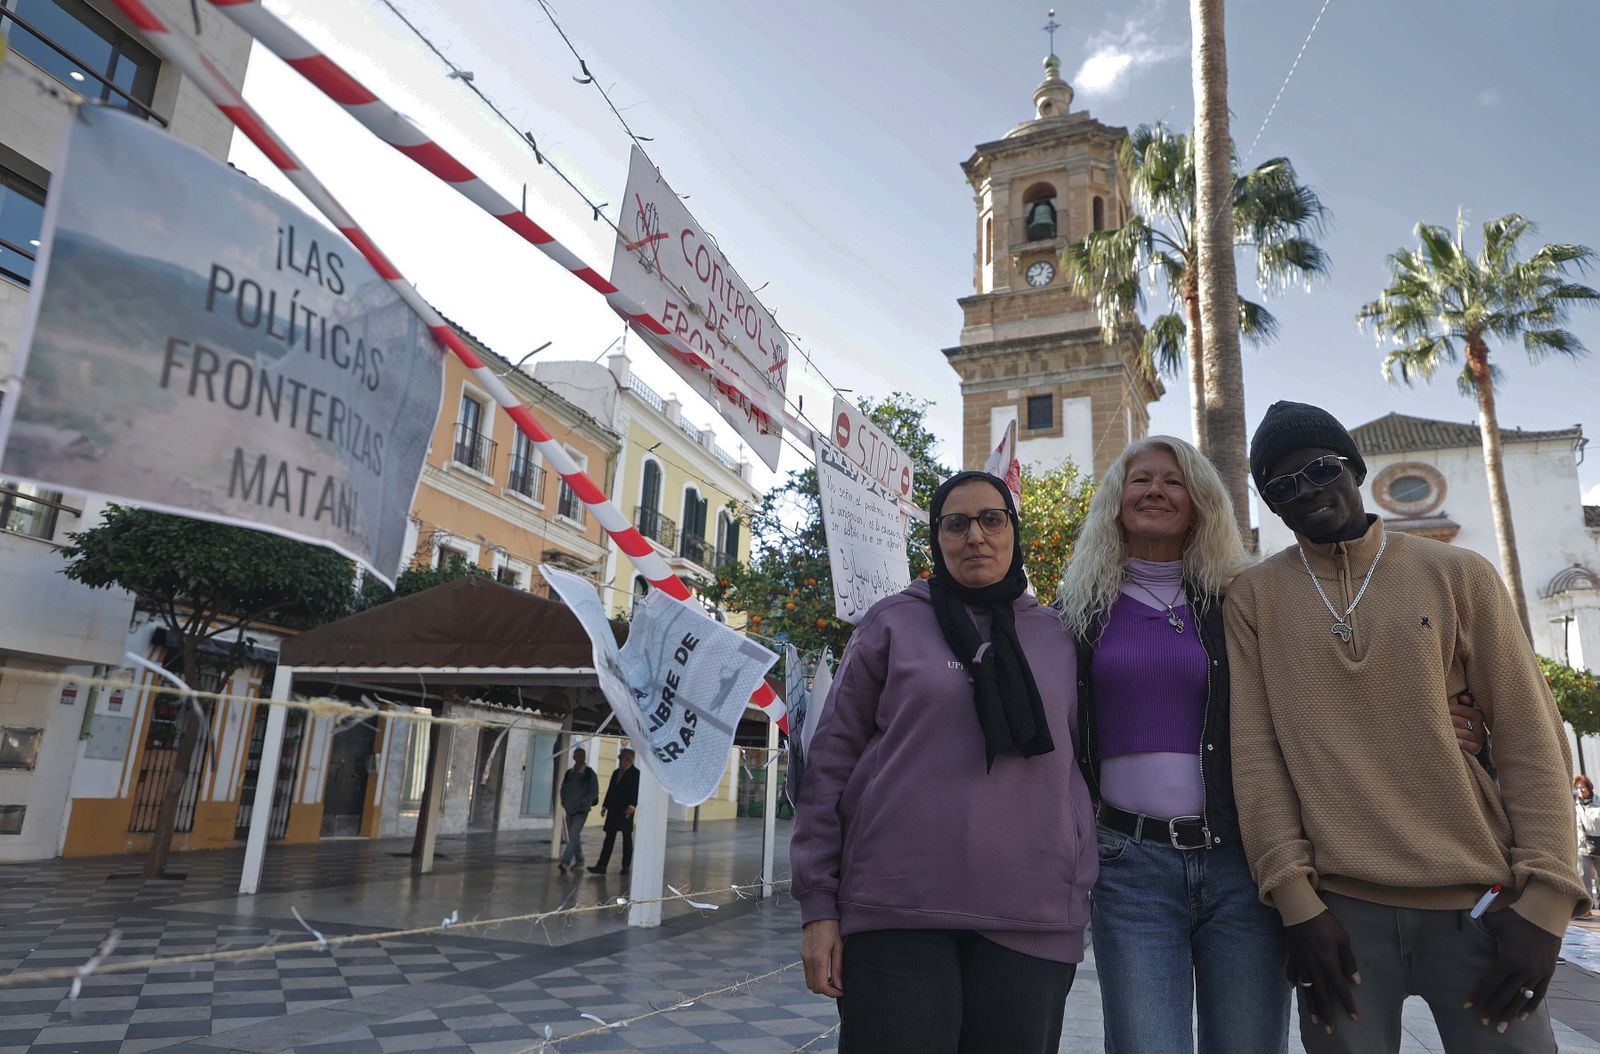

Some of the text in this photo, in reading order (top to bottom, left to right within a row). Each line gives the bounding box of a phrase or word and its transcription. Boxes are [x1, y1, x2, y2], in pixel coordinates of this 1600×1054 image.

[276, 225, 345, 295] ¡LAS
[205, 263, 385, 391] POLÍTICAS
[159, 336, 384, 477] FRONTERIZAS
[228, 447, 358, 533] MATAN!
[858, 424, 898, 485] STOP
[674, 632, 700, 666] DE
